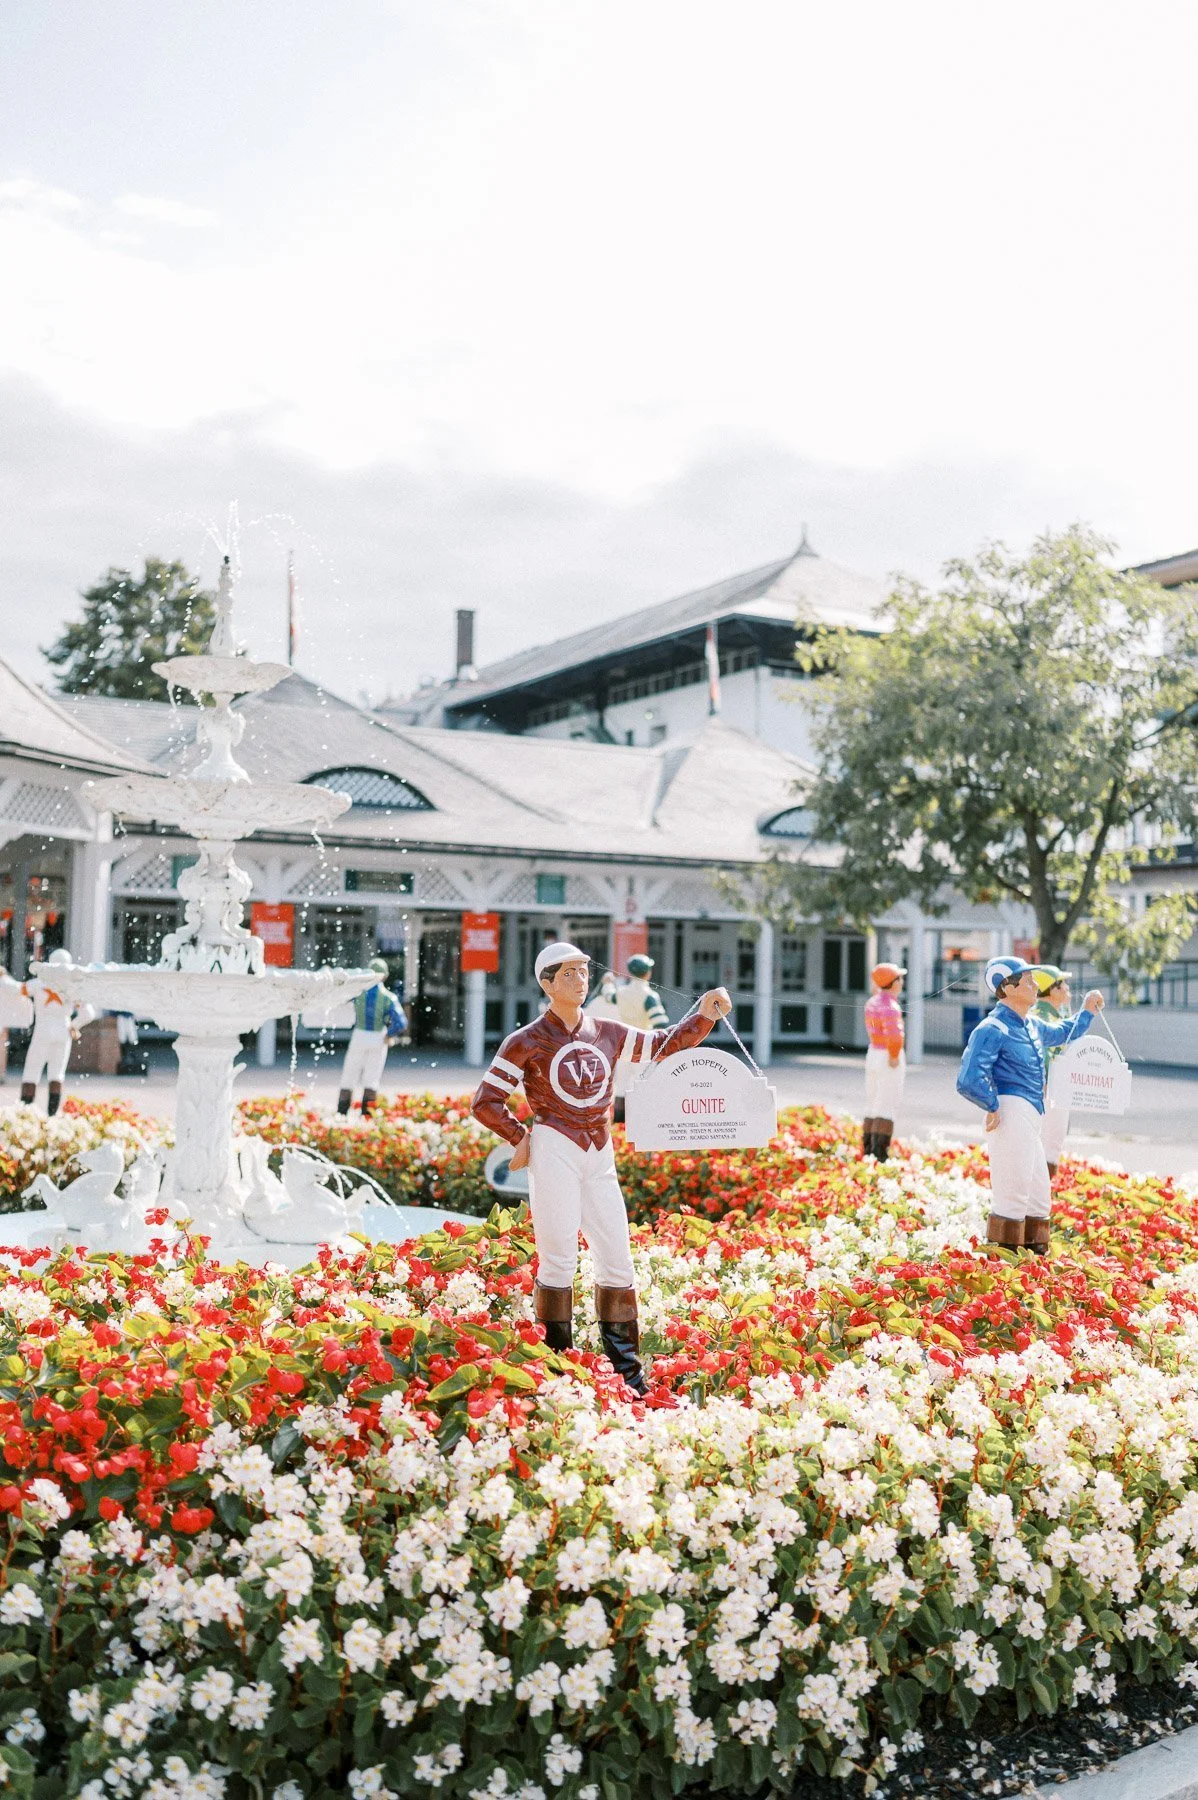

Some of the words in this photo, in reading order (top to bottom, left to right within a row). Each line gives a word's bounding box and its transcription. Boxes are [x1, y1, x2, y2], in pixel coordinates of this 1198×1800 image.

[563, 1058, 599, 1087] W
[670, 1062, 688, 1077] THE
[691, 1058, 728, 1077] HOPEFUL
[1070, 1072, 1114, 1089] MALATHAAT
[681, 1097, 726, 1114] GUNITE
